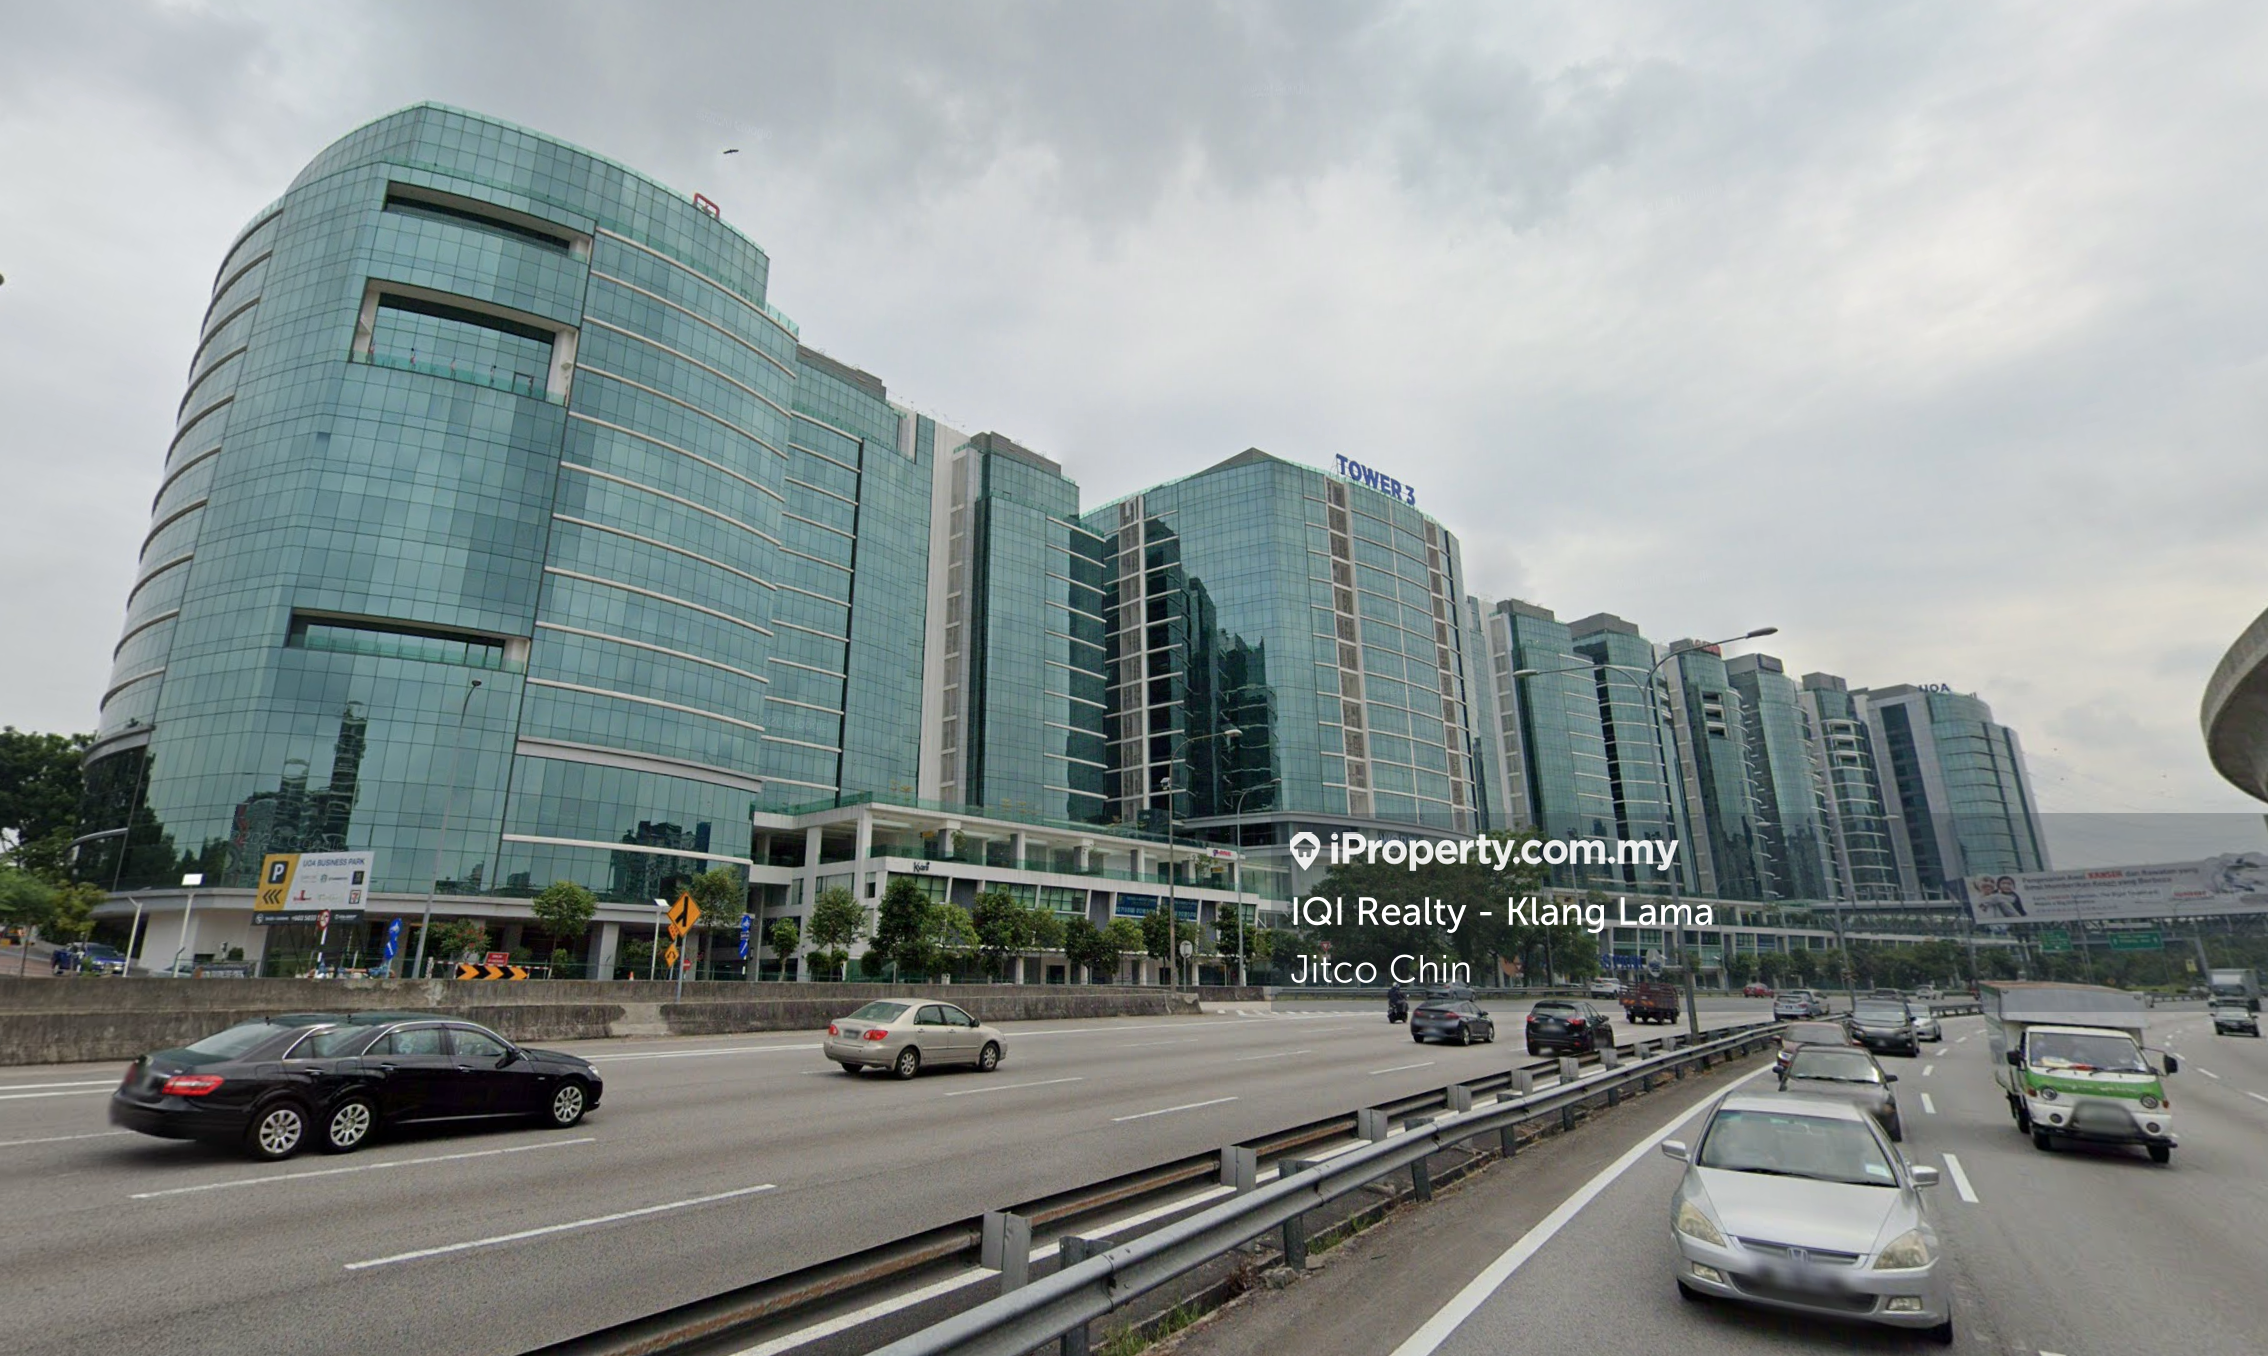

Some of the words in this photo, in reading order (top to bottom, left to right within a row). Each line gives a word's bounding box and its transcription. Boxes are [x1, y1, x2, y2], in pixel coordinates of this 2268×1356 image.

[1336, 453, 1402, 501] TOWER
[1406, 485, 1416, 506] 3
[302, 859, 316, 867] UOA
[317, 858, 348, 867] BUSINESS
[348, 857, 365, 866] PARK
[272, 863, 285, 883] P
